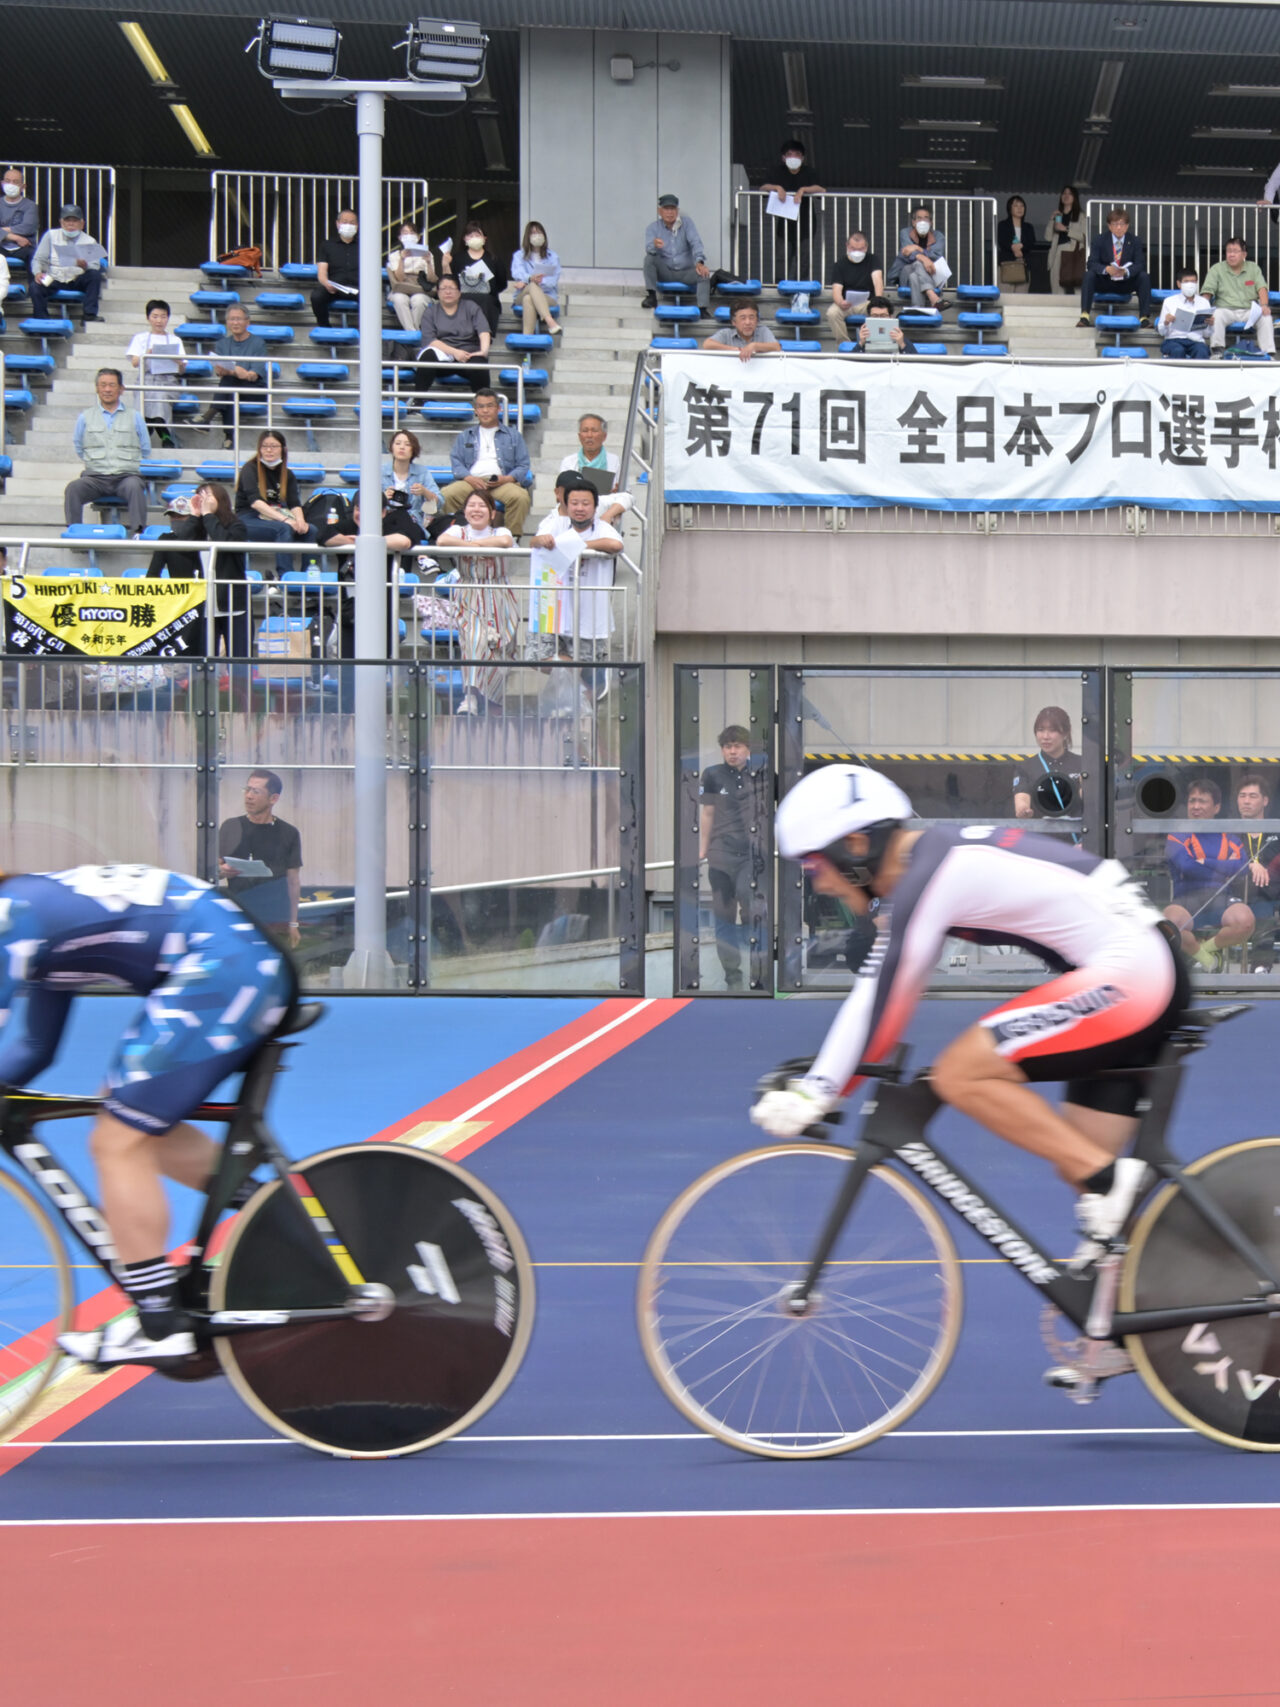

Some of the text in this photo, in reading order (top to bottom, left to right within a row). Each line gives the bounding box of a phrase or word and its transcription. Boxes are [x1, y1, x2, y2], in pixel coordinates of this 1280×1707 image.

[683, 381, 867, 464] 第71回
[11, 574, 27, 599] 5
[34, 582, 190, 597] HIROYUKI MURAKAMI
[51, 603, 156, 628] 優 KYOTO 勝
[81, 633, 127, 646] 令和元年
[894, 1142, 1061, 1284] BRIDGESTONE
